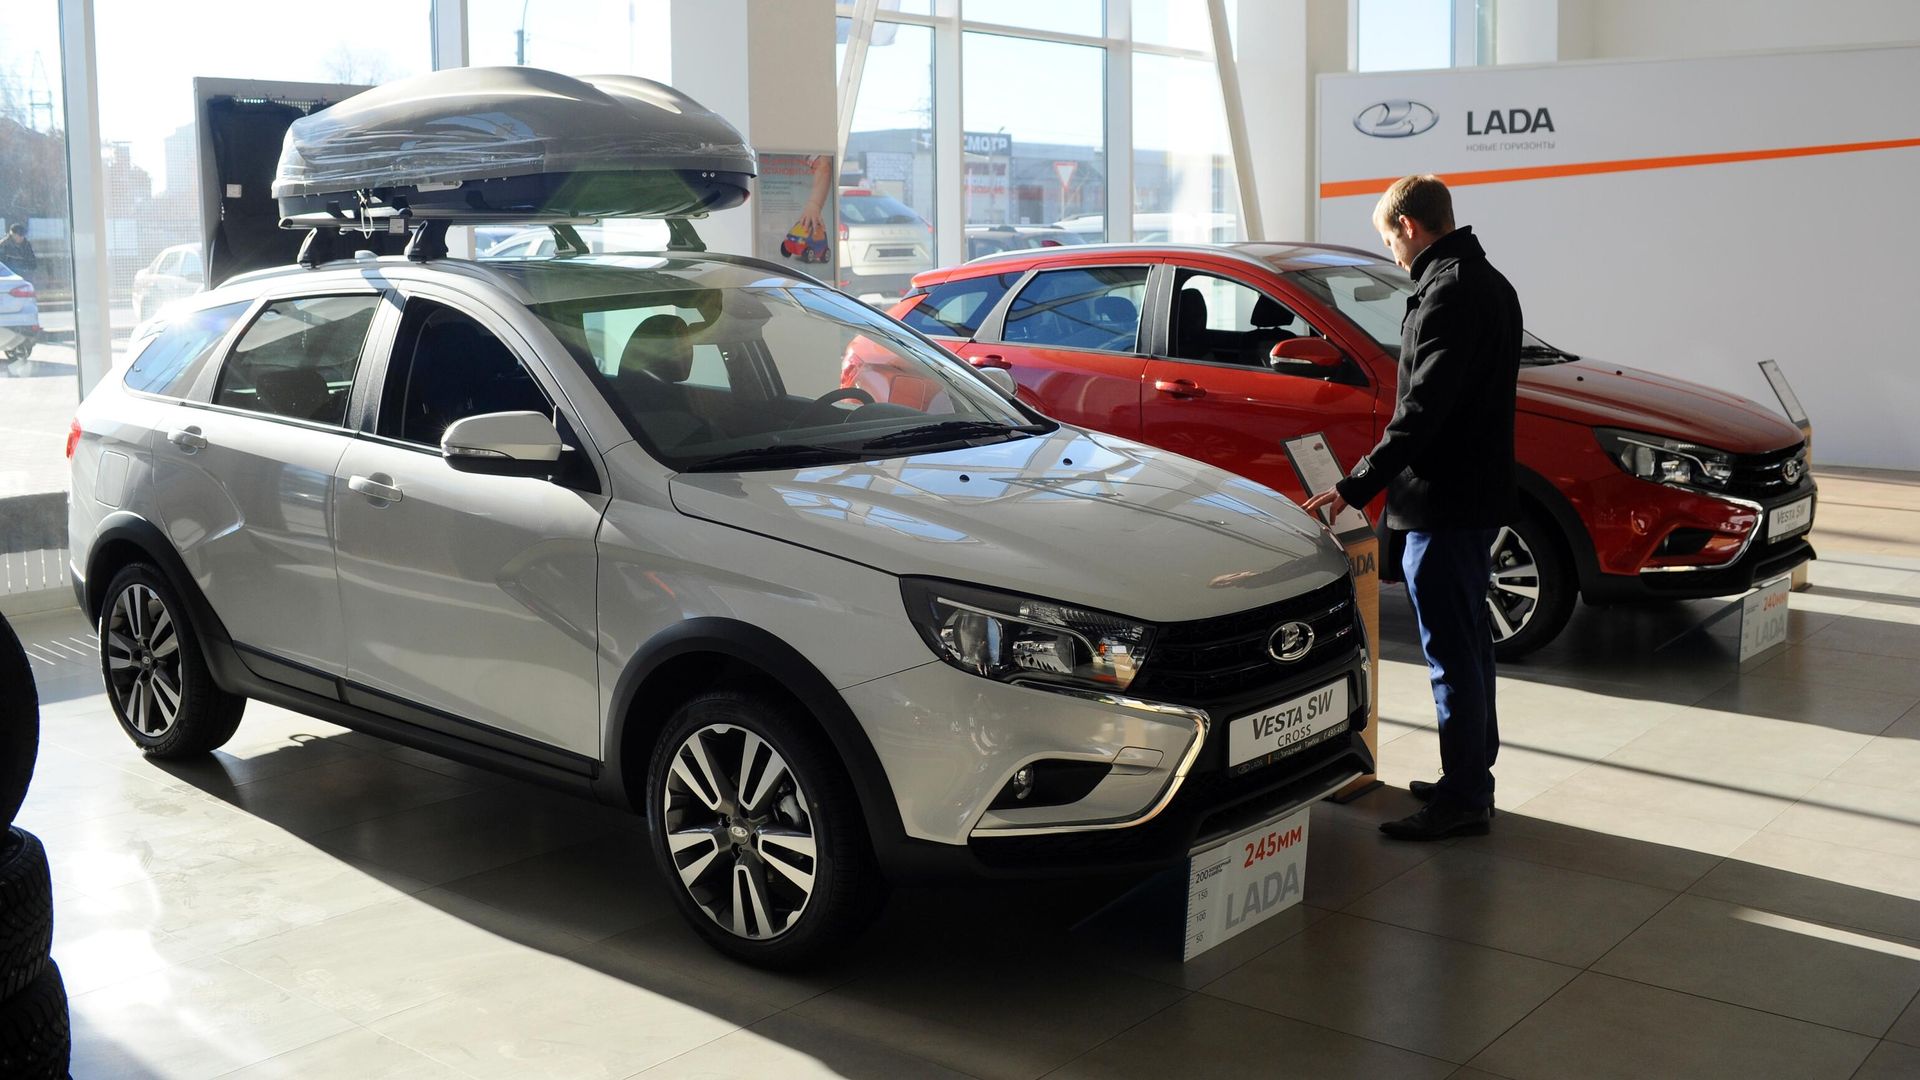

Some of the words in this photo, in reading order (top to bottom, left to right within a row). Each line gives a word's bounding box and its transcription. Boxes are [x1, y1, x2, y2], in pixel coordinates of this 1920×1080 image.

[1467, 107, 1555, 136] LADA
[1466, 143, 1498, 151] НОВЫЕ
[1500, 140, 1555, 151] ГОРИЗОНТЫ
[1252, 706, 1303, 740] VESTA
[1307, 689, 1334, 720] SW
[1277, 724, 1312, 748] CROSS
[1195, 870, 1209, 884] 200
[1198, 890, 1209, 900] 150
[1225, 862, 1300, 930] LADA
[1196, 912, 1207, 923] 100
[1195, 934, 1204, 943] 50
